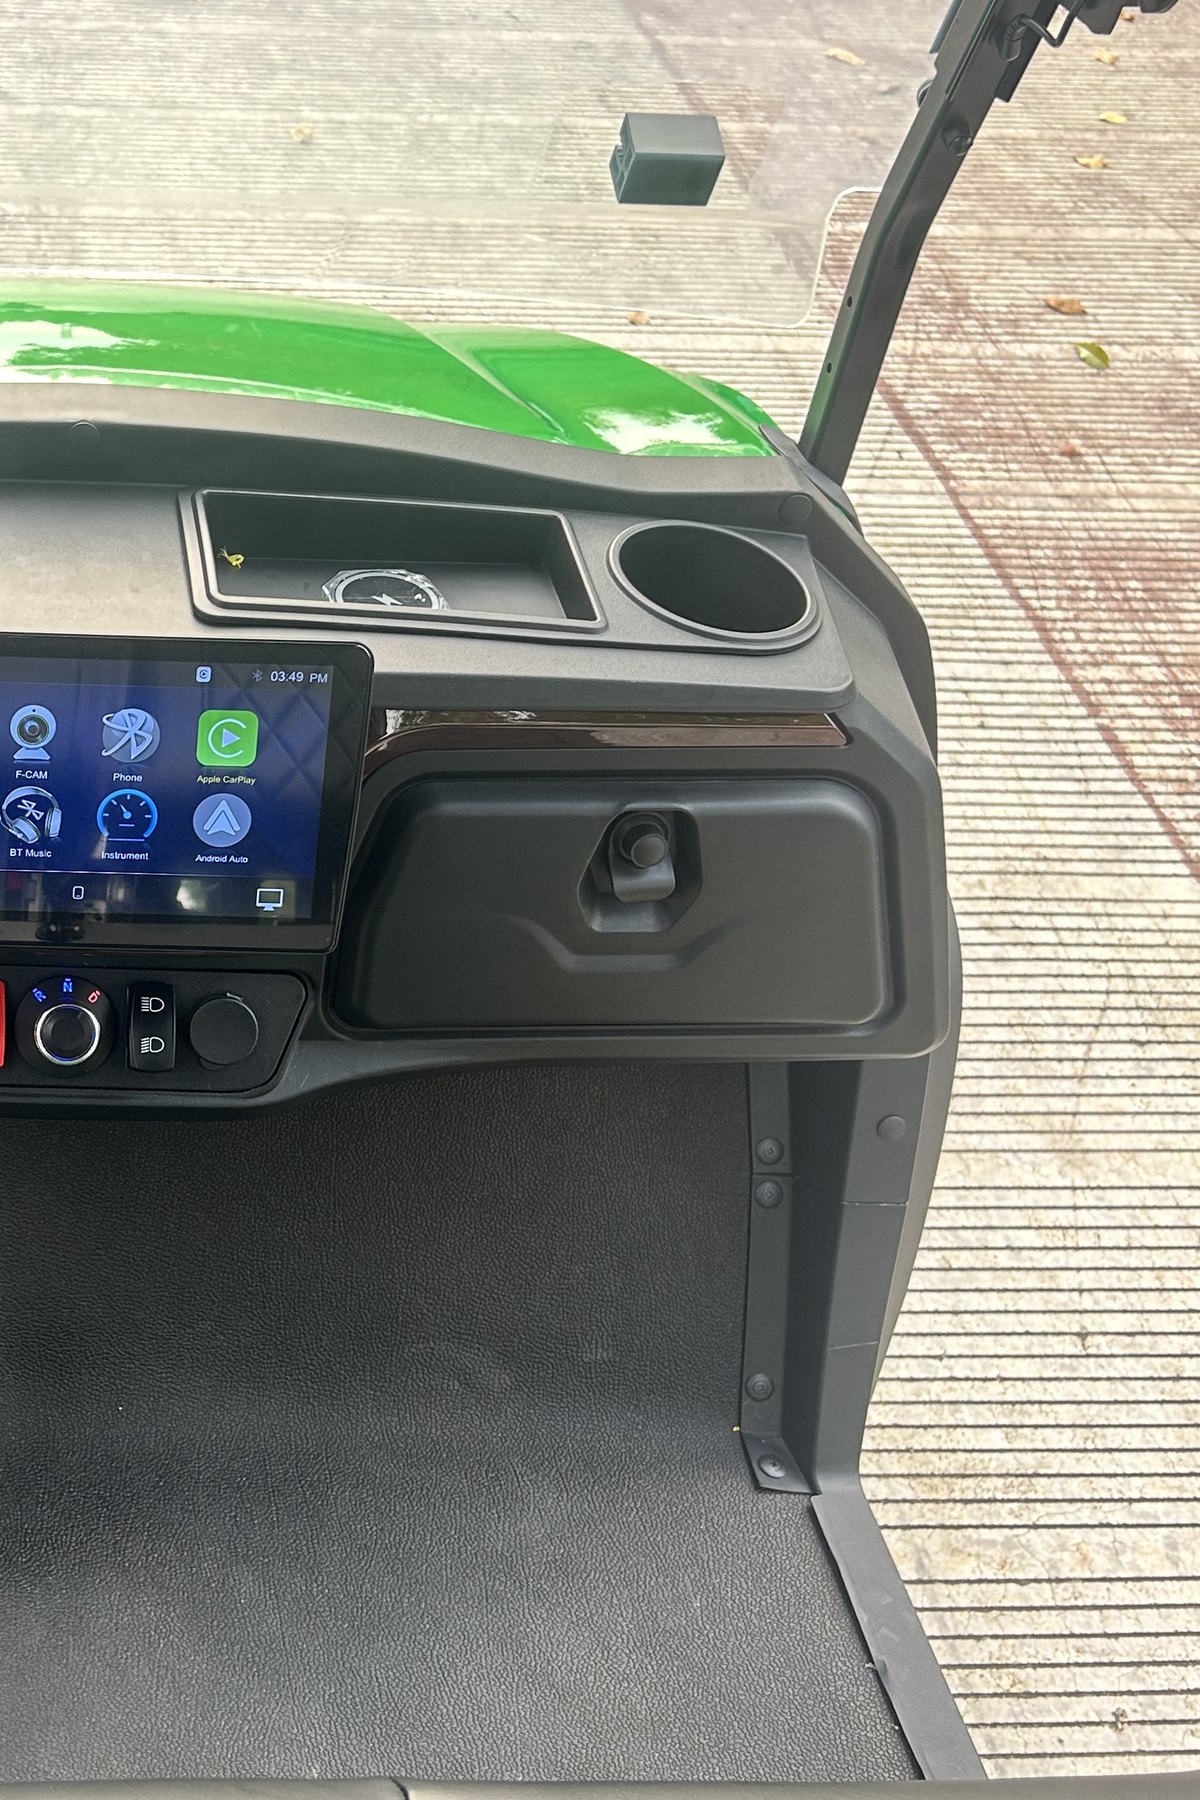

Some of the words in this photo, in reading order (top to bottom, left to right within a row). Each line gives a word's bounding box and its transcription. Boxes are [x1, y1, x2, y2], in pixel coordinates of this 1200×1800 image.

[270, 670, 304, 682] 03:49
[309, 673, 328, 683] PM
[15, 770, 48, 780] F-CAM
[112, 772, 143, 783] Phone
[196, 774, 221, 785] Apple
[222, 775, 256, 786] CarPlay
[9, 848, 23, 857] BT
[25, 849, 52, 858] Music
[101, 850, 149, 861] Instrument
[195, 854, 227, 863] Android
[228, 855, 249, 864] Auto
[63, 981, 73, 993] N
